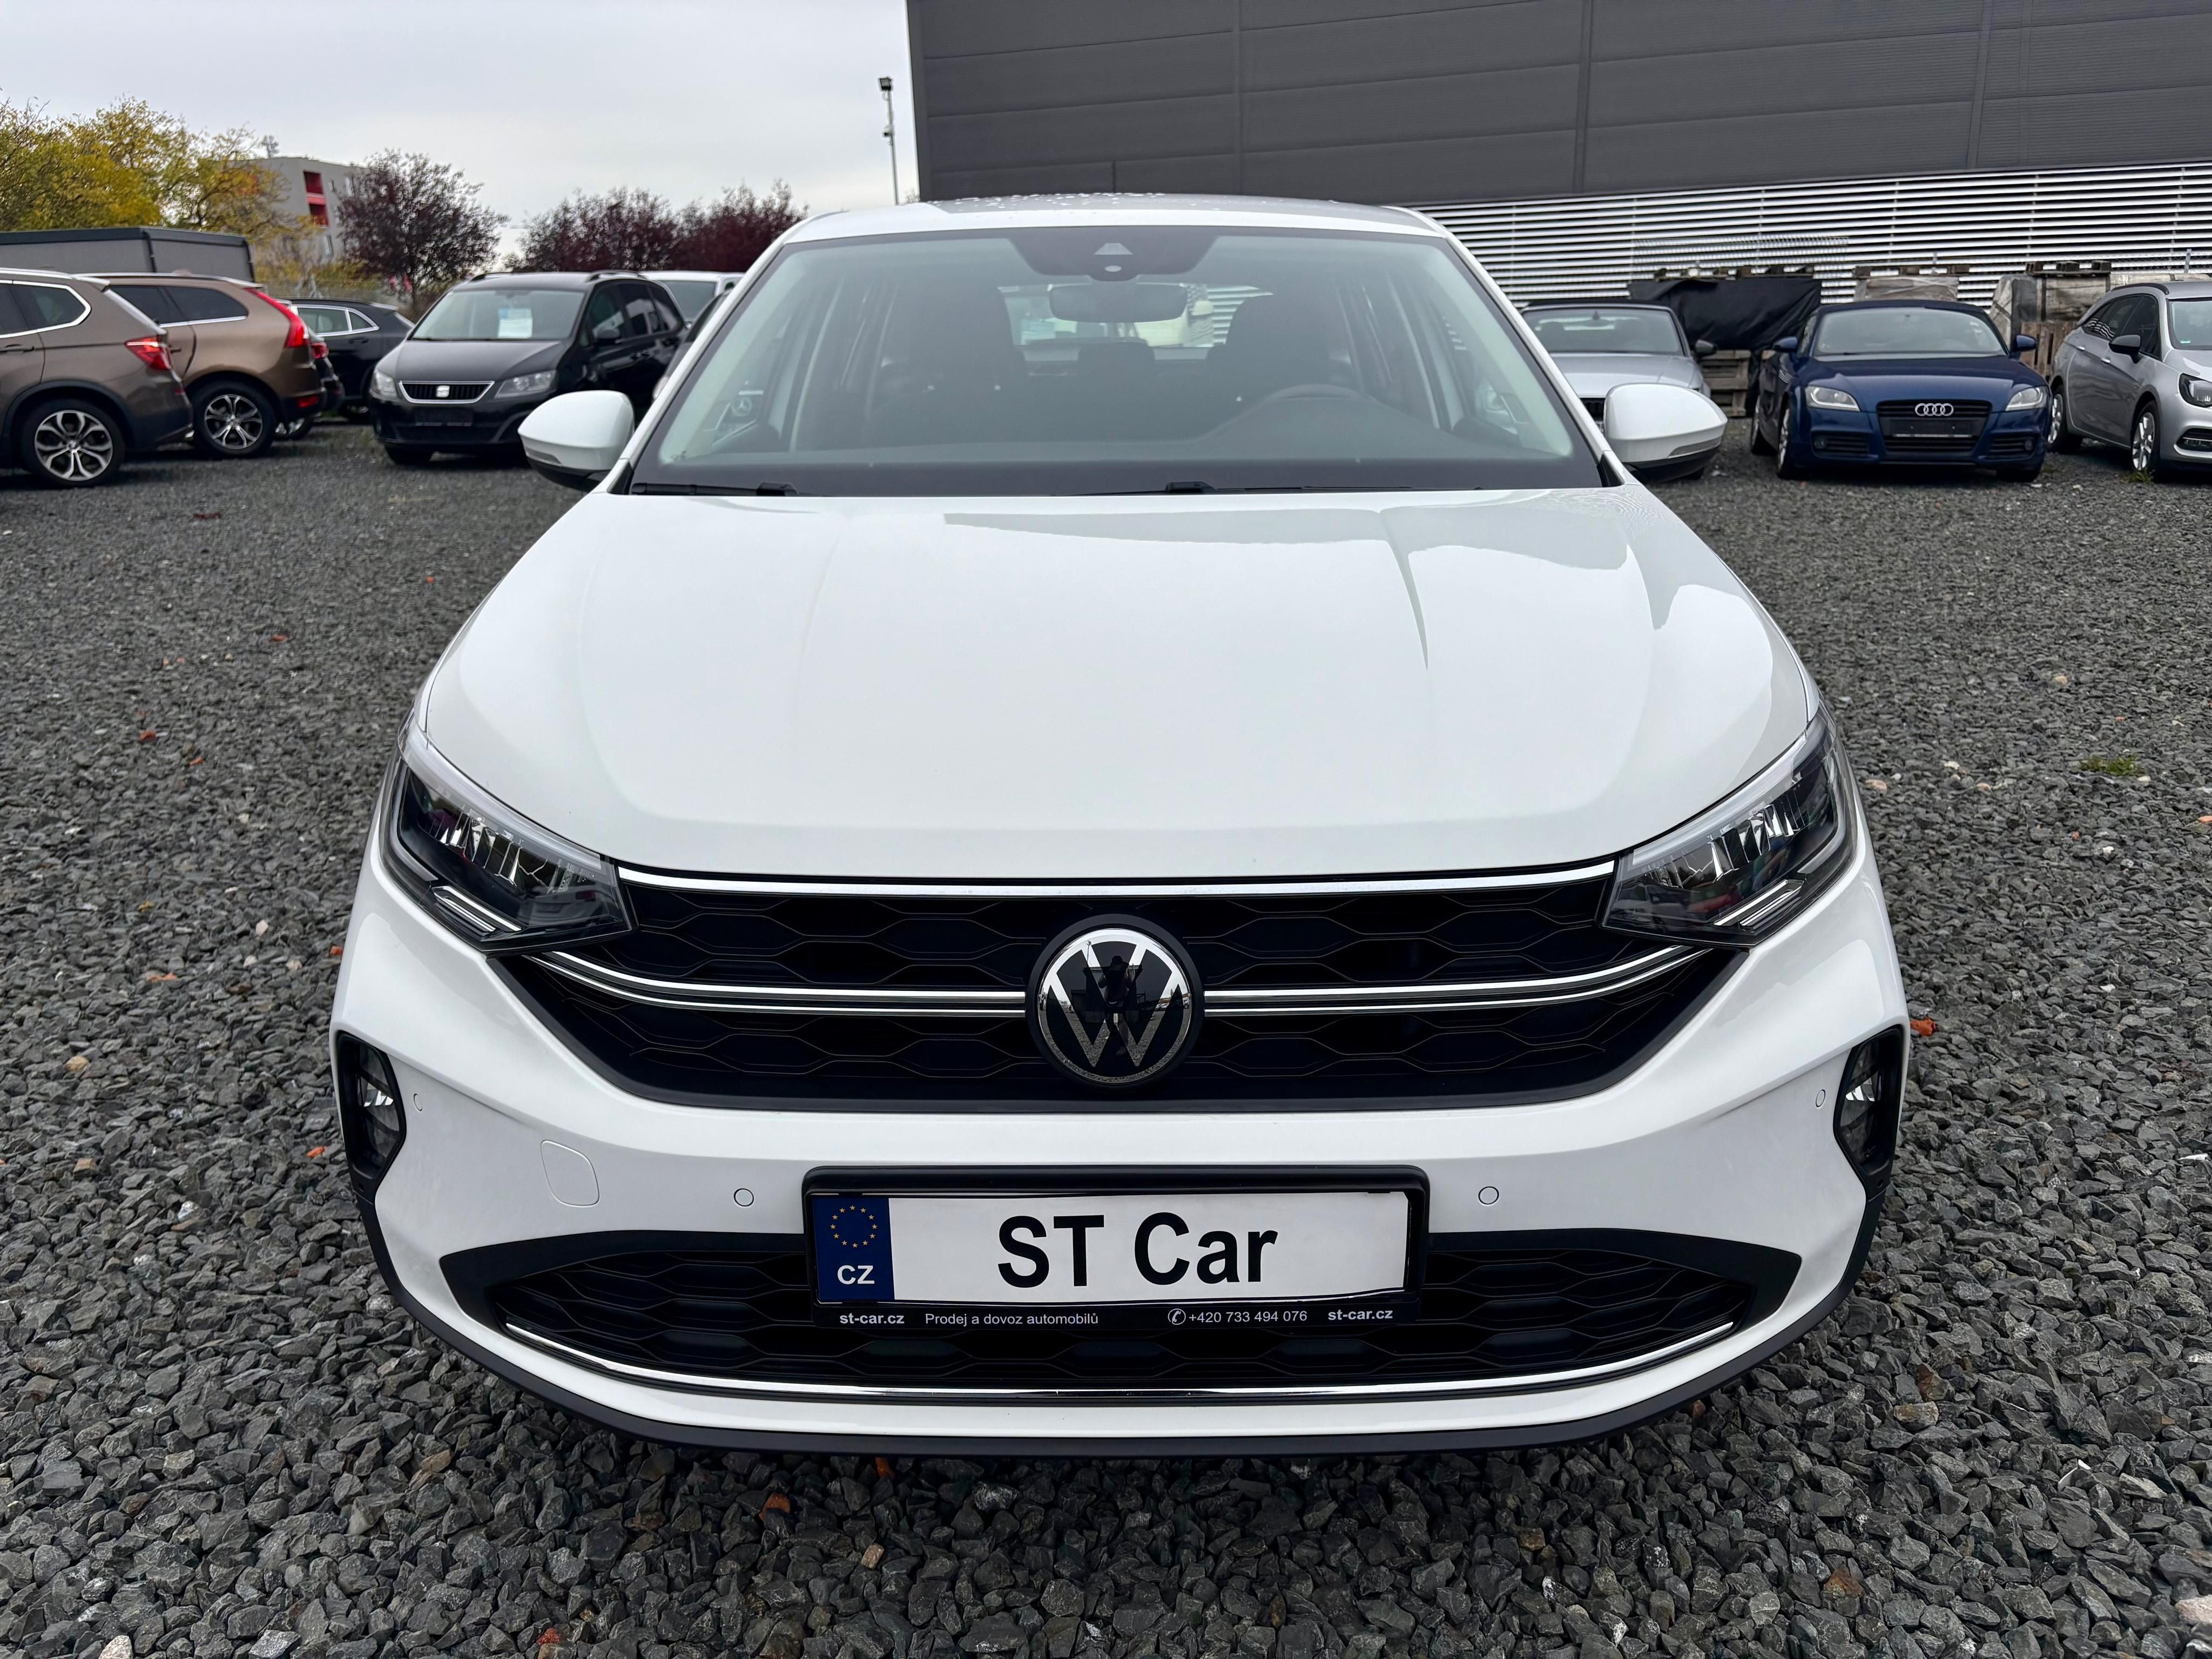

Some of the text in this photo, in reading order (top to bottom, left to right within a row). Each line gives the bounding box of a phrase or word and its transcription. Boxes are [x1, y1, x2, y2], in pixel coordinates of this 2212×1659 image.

[997, 1212, 1279, 1288] ST Car
[837, 1265, 875, 1285] CZ
[839, 1312, 905, 1324] st-car.cz
[925, 1313, 1098, 1327] Prodej a dovoz automobilů
[1189, 1310, 1307, 1323] +420 733 494 076
[1327, 1309, 1393, 1320] st-car.cz
